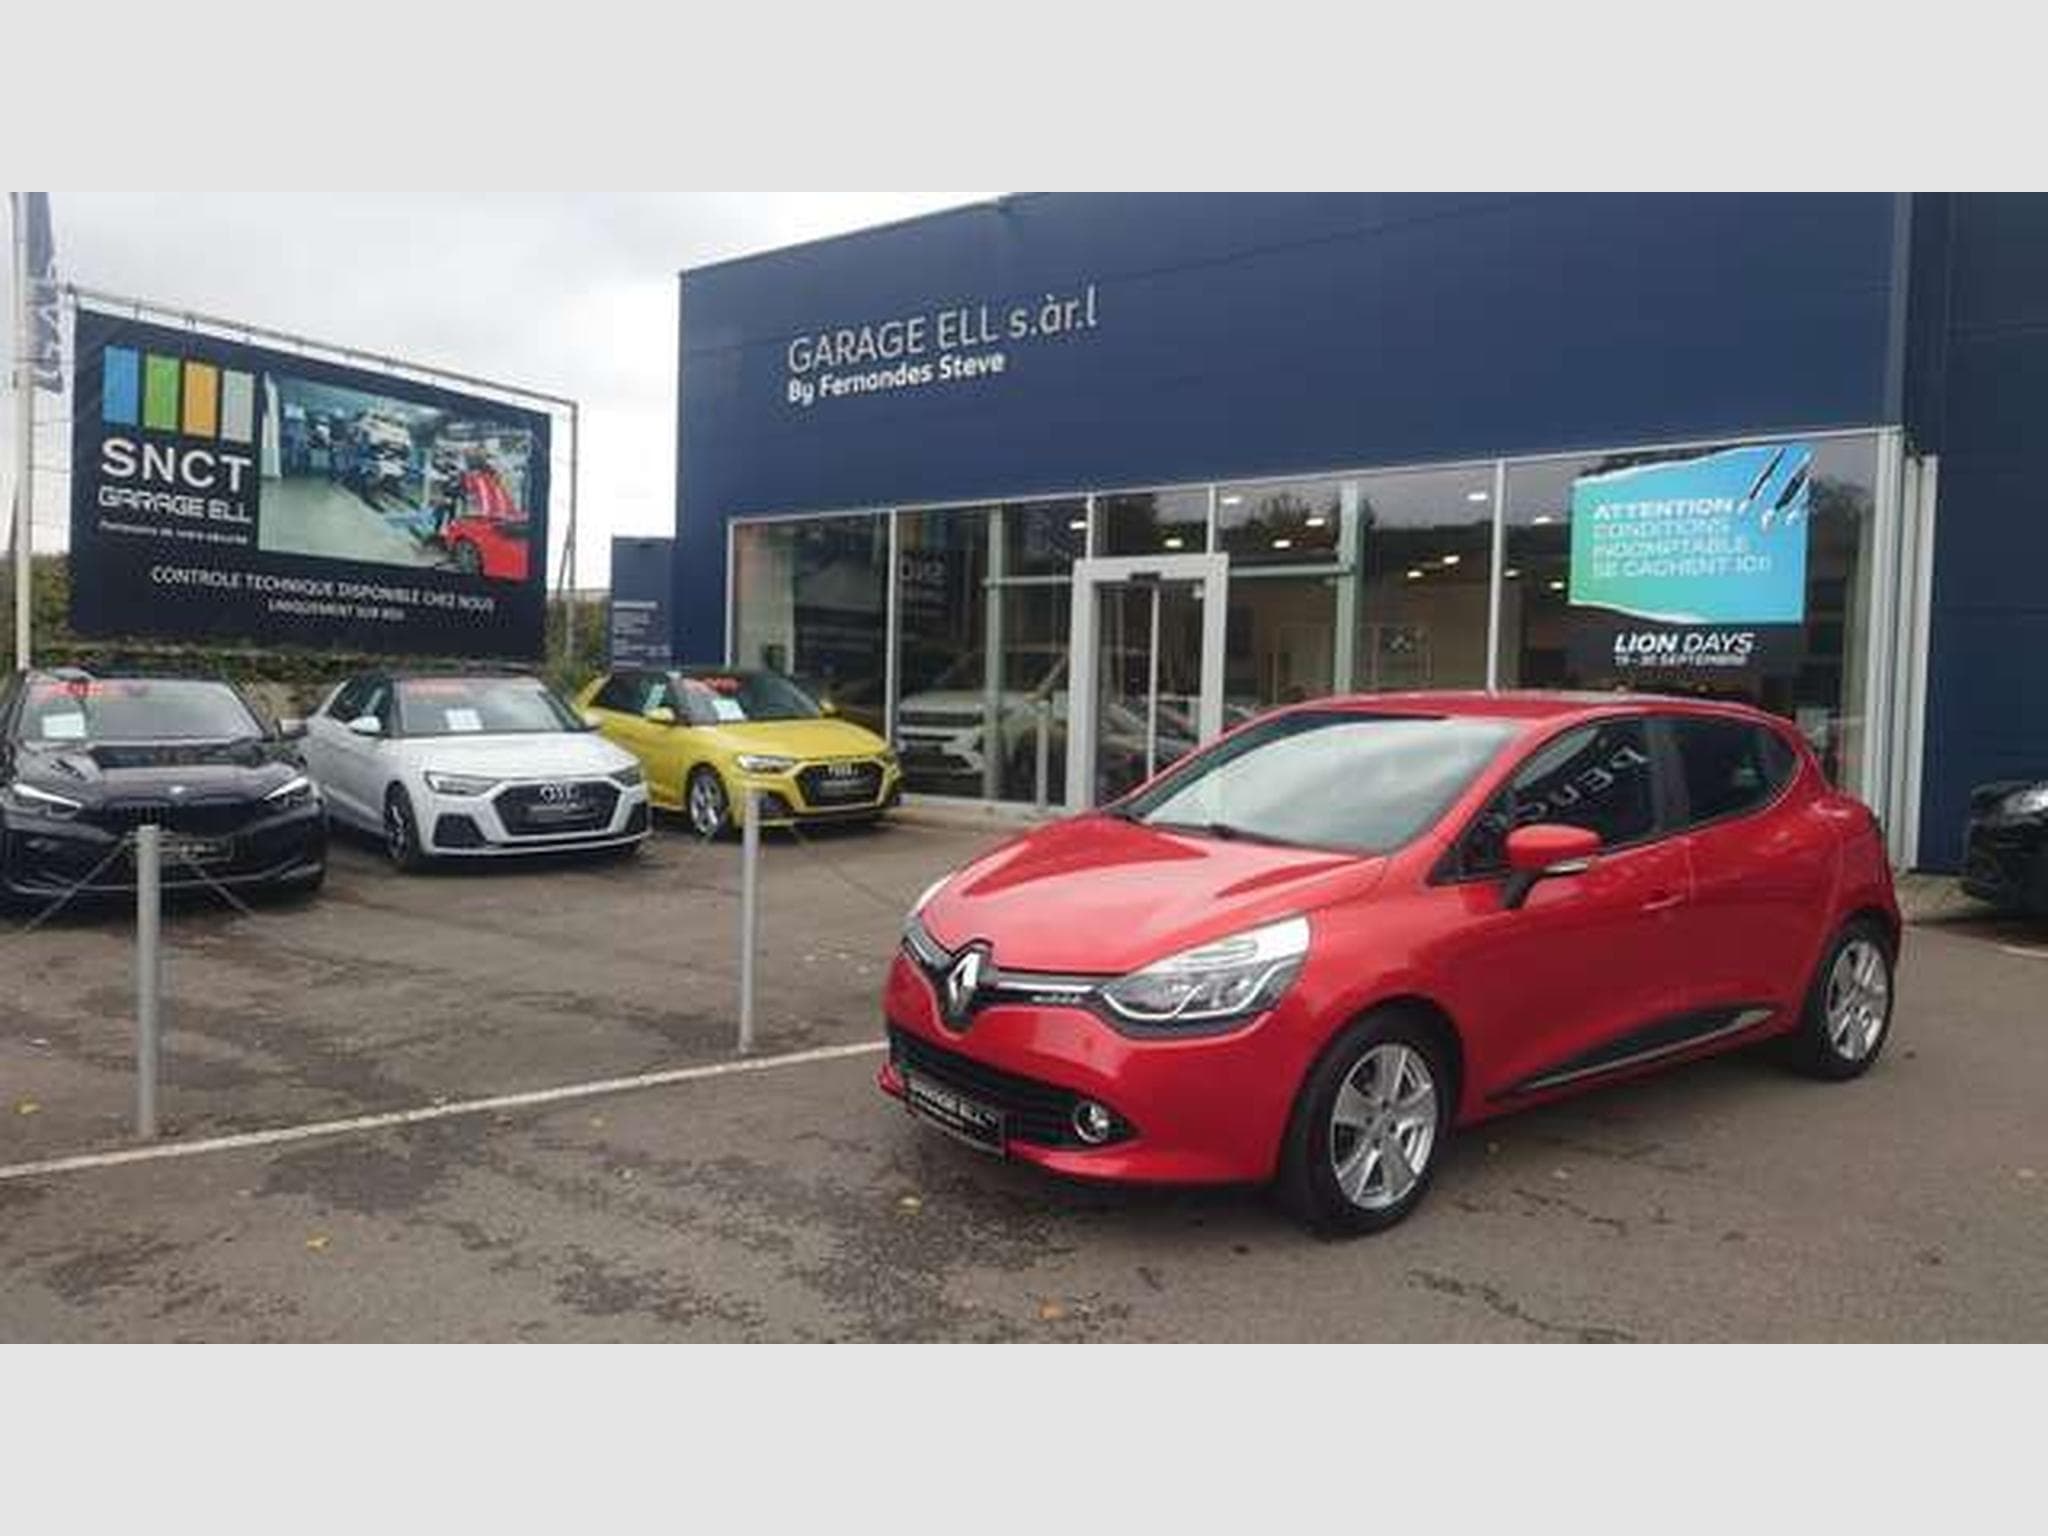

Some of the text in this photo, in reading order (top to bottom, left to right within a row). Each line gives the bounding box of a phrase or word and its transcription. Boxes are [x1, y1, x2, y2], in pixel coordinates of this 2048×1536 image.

[787, 316, 926, 373] GARAGE
[937, 306, 1001, 350] ELL
[788, 351, 1006, 405] By Fernandes Steve
[101, 437, 252, 493] SNCT
[99, 485, 253, 524] GARAGE ELL
[1593, 498, 1734, 520] ATTENTION
[151, 564, 240, 589] CONTROLE
[1614, 632, 1755, 655] LION DAYS
